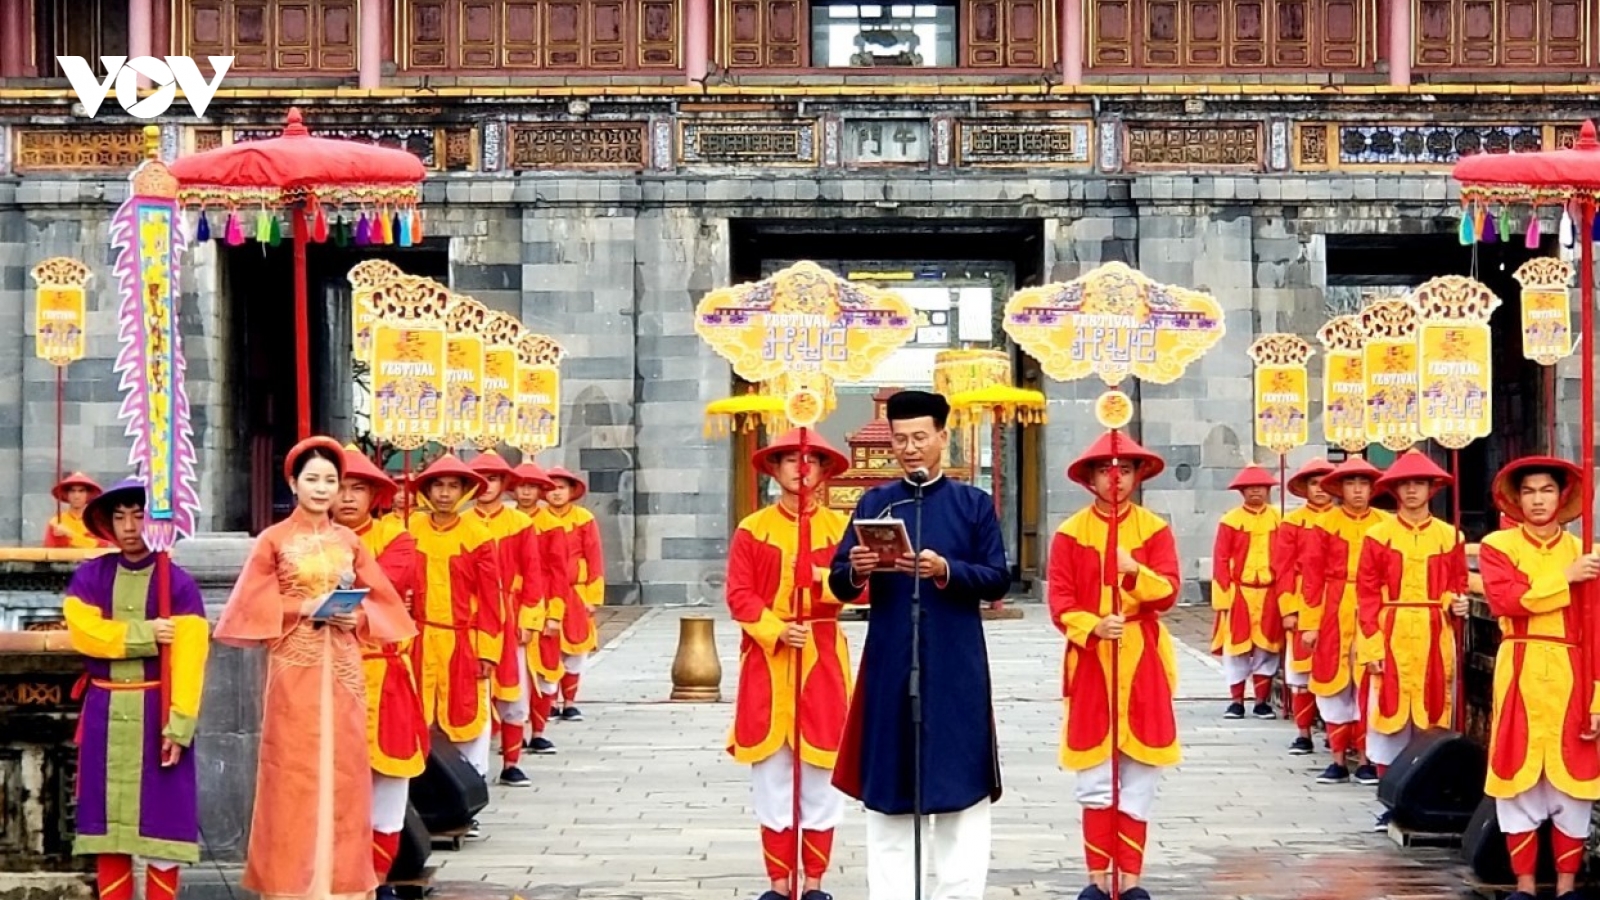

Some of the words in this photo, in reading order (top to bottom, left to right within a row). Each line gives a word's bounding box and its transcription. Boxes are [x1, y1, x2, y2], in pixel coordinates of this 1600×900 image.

[763, 314, 830, 328] FESTIVAL
[1072, 314, 1139, 328] FESTIVAL
[380, 361, 437, 376] FESTIVAL
[1428, 361, 1480, 375] FESTIVAL
[385, 419, 431, 433] 2024
